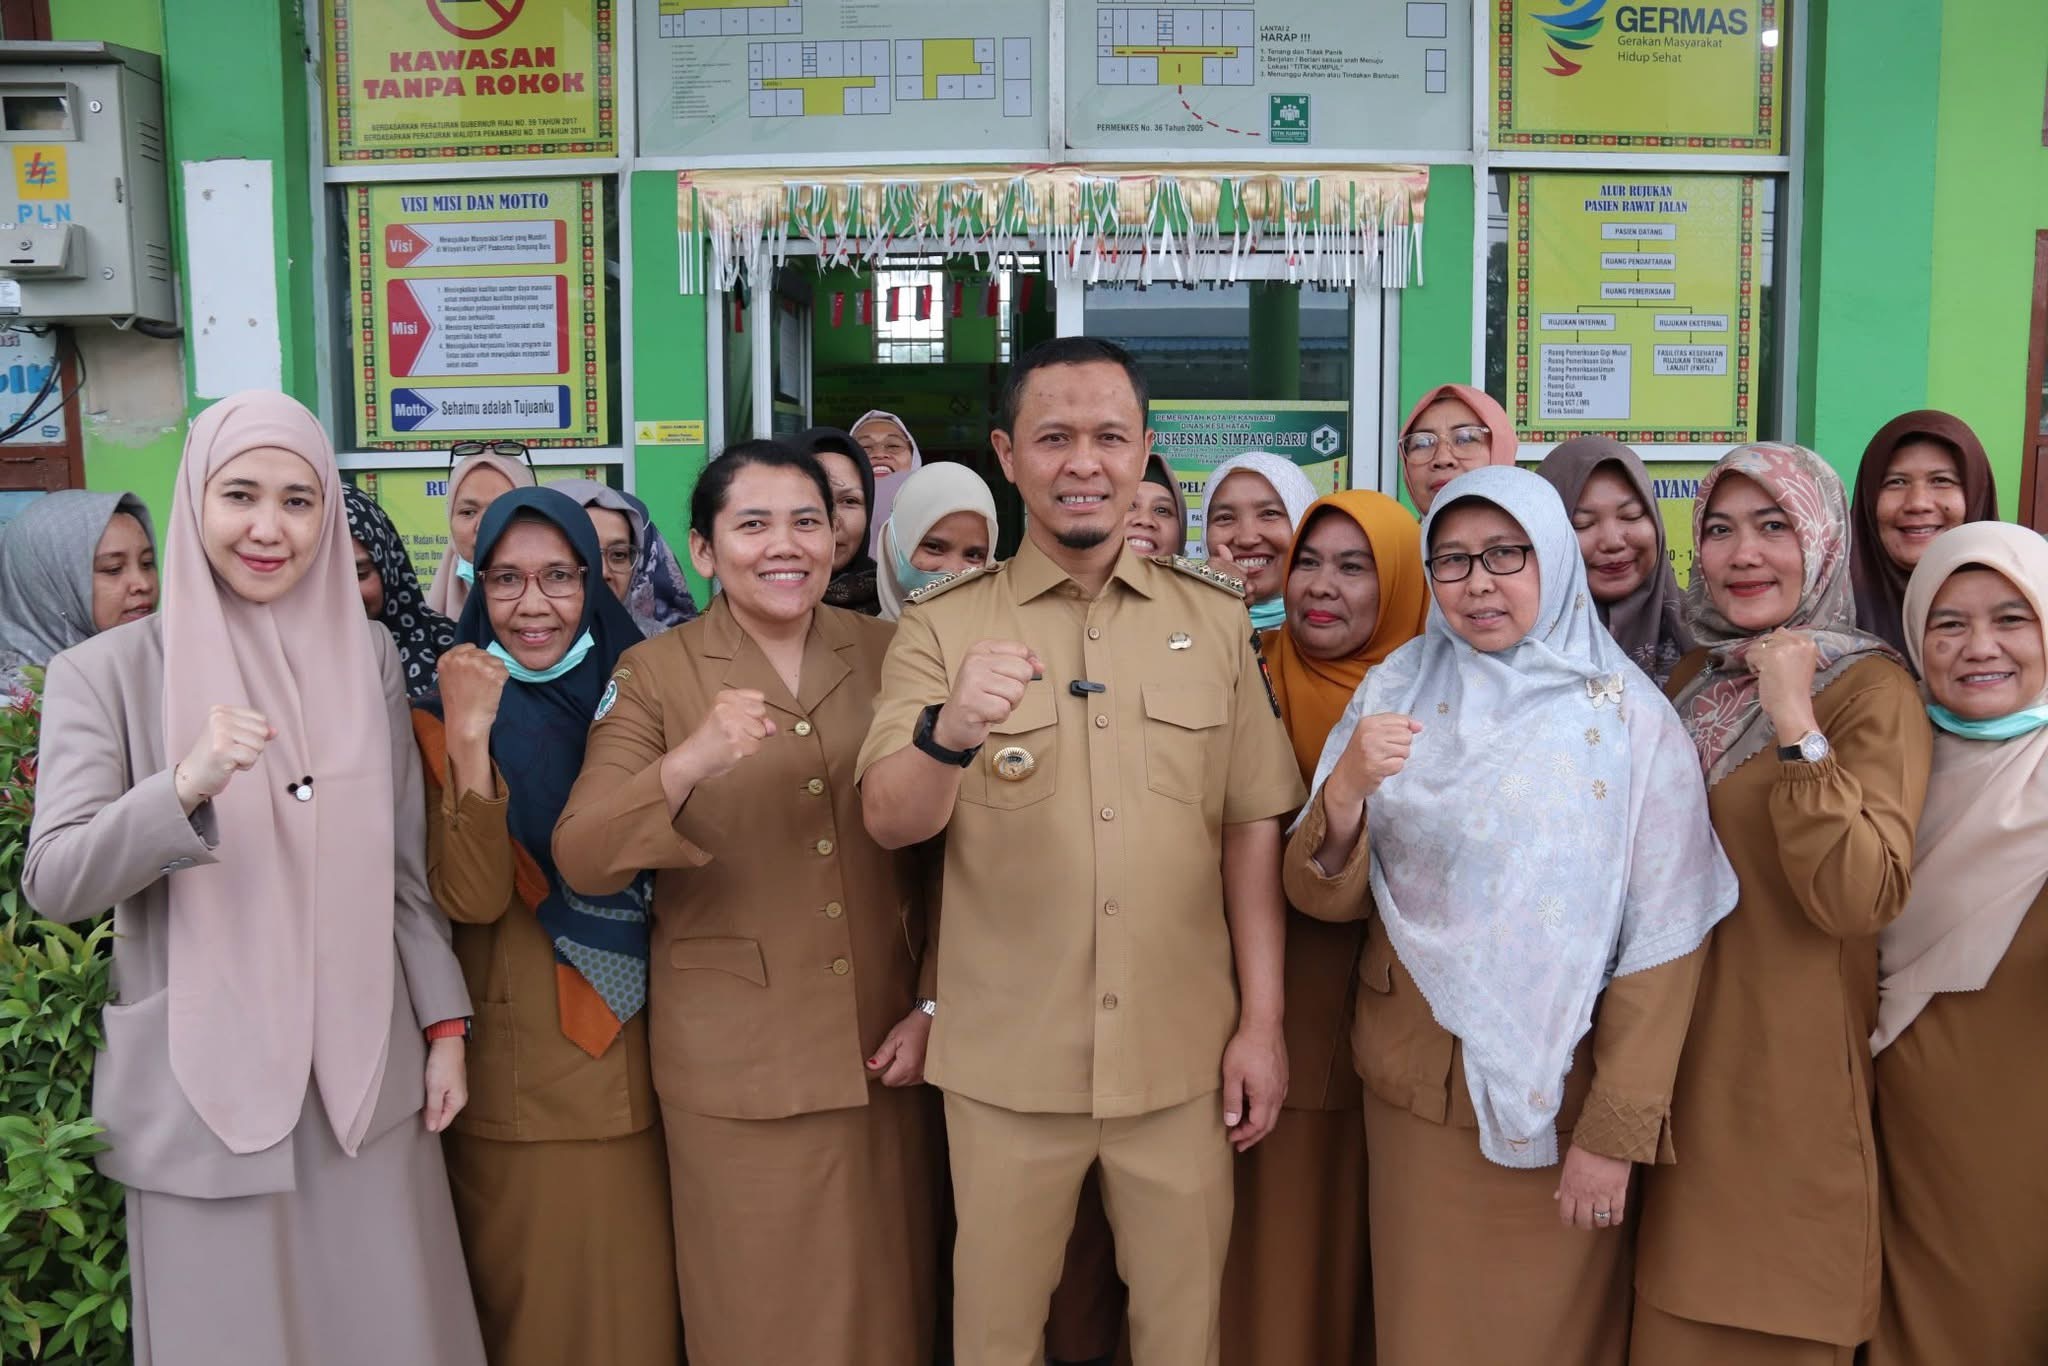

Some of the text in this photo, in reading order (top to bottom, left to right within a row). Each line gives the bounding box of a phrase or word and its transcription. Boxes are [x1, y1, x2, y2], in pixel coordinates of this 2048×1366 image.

[1615, 6, 1748, 35] GERMAS
[1260, 33, 1311, 42] HARAP !!!
[1617, 36, 1722, 49] Gerakan Masyarakat
[390, 47, 555, 72] KAWASAN
[1617, 52, 1682, 63] Hidup Sehat
[363, 73, 584, 99] TANPA ROKOK
[1187, 124, 1204, 132] 2005
[1600, 185, 1672, 198] ALUR RUJUKAN
[401, 193, 549, 212] VISI MISI DAN MOTTO
[1585, 200, 1688, 213] PASIEN RAWAT JALAN
[17, 203, 71, 223] PLN
[390, 239, 413, 253] Visi
[392, 322, 418, 335] Misi
[1659, 319, 1688, 327] RUJUKAN
[395, 399, 554, 417] Motto Sehatmu adalah Tujuanku
[1221, 433, 1272, 446] SIMPANG
[1276, 433, 1308, 446] BARU
